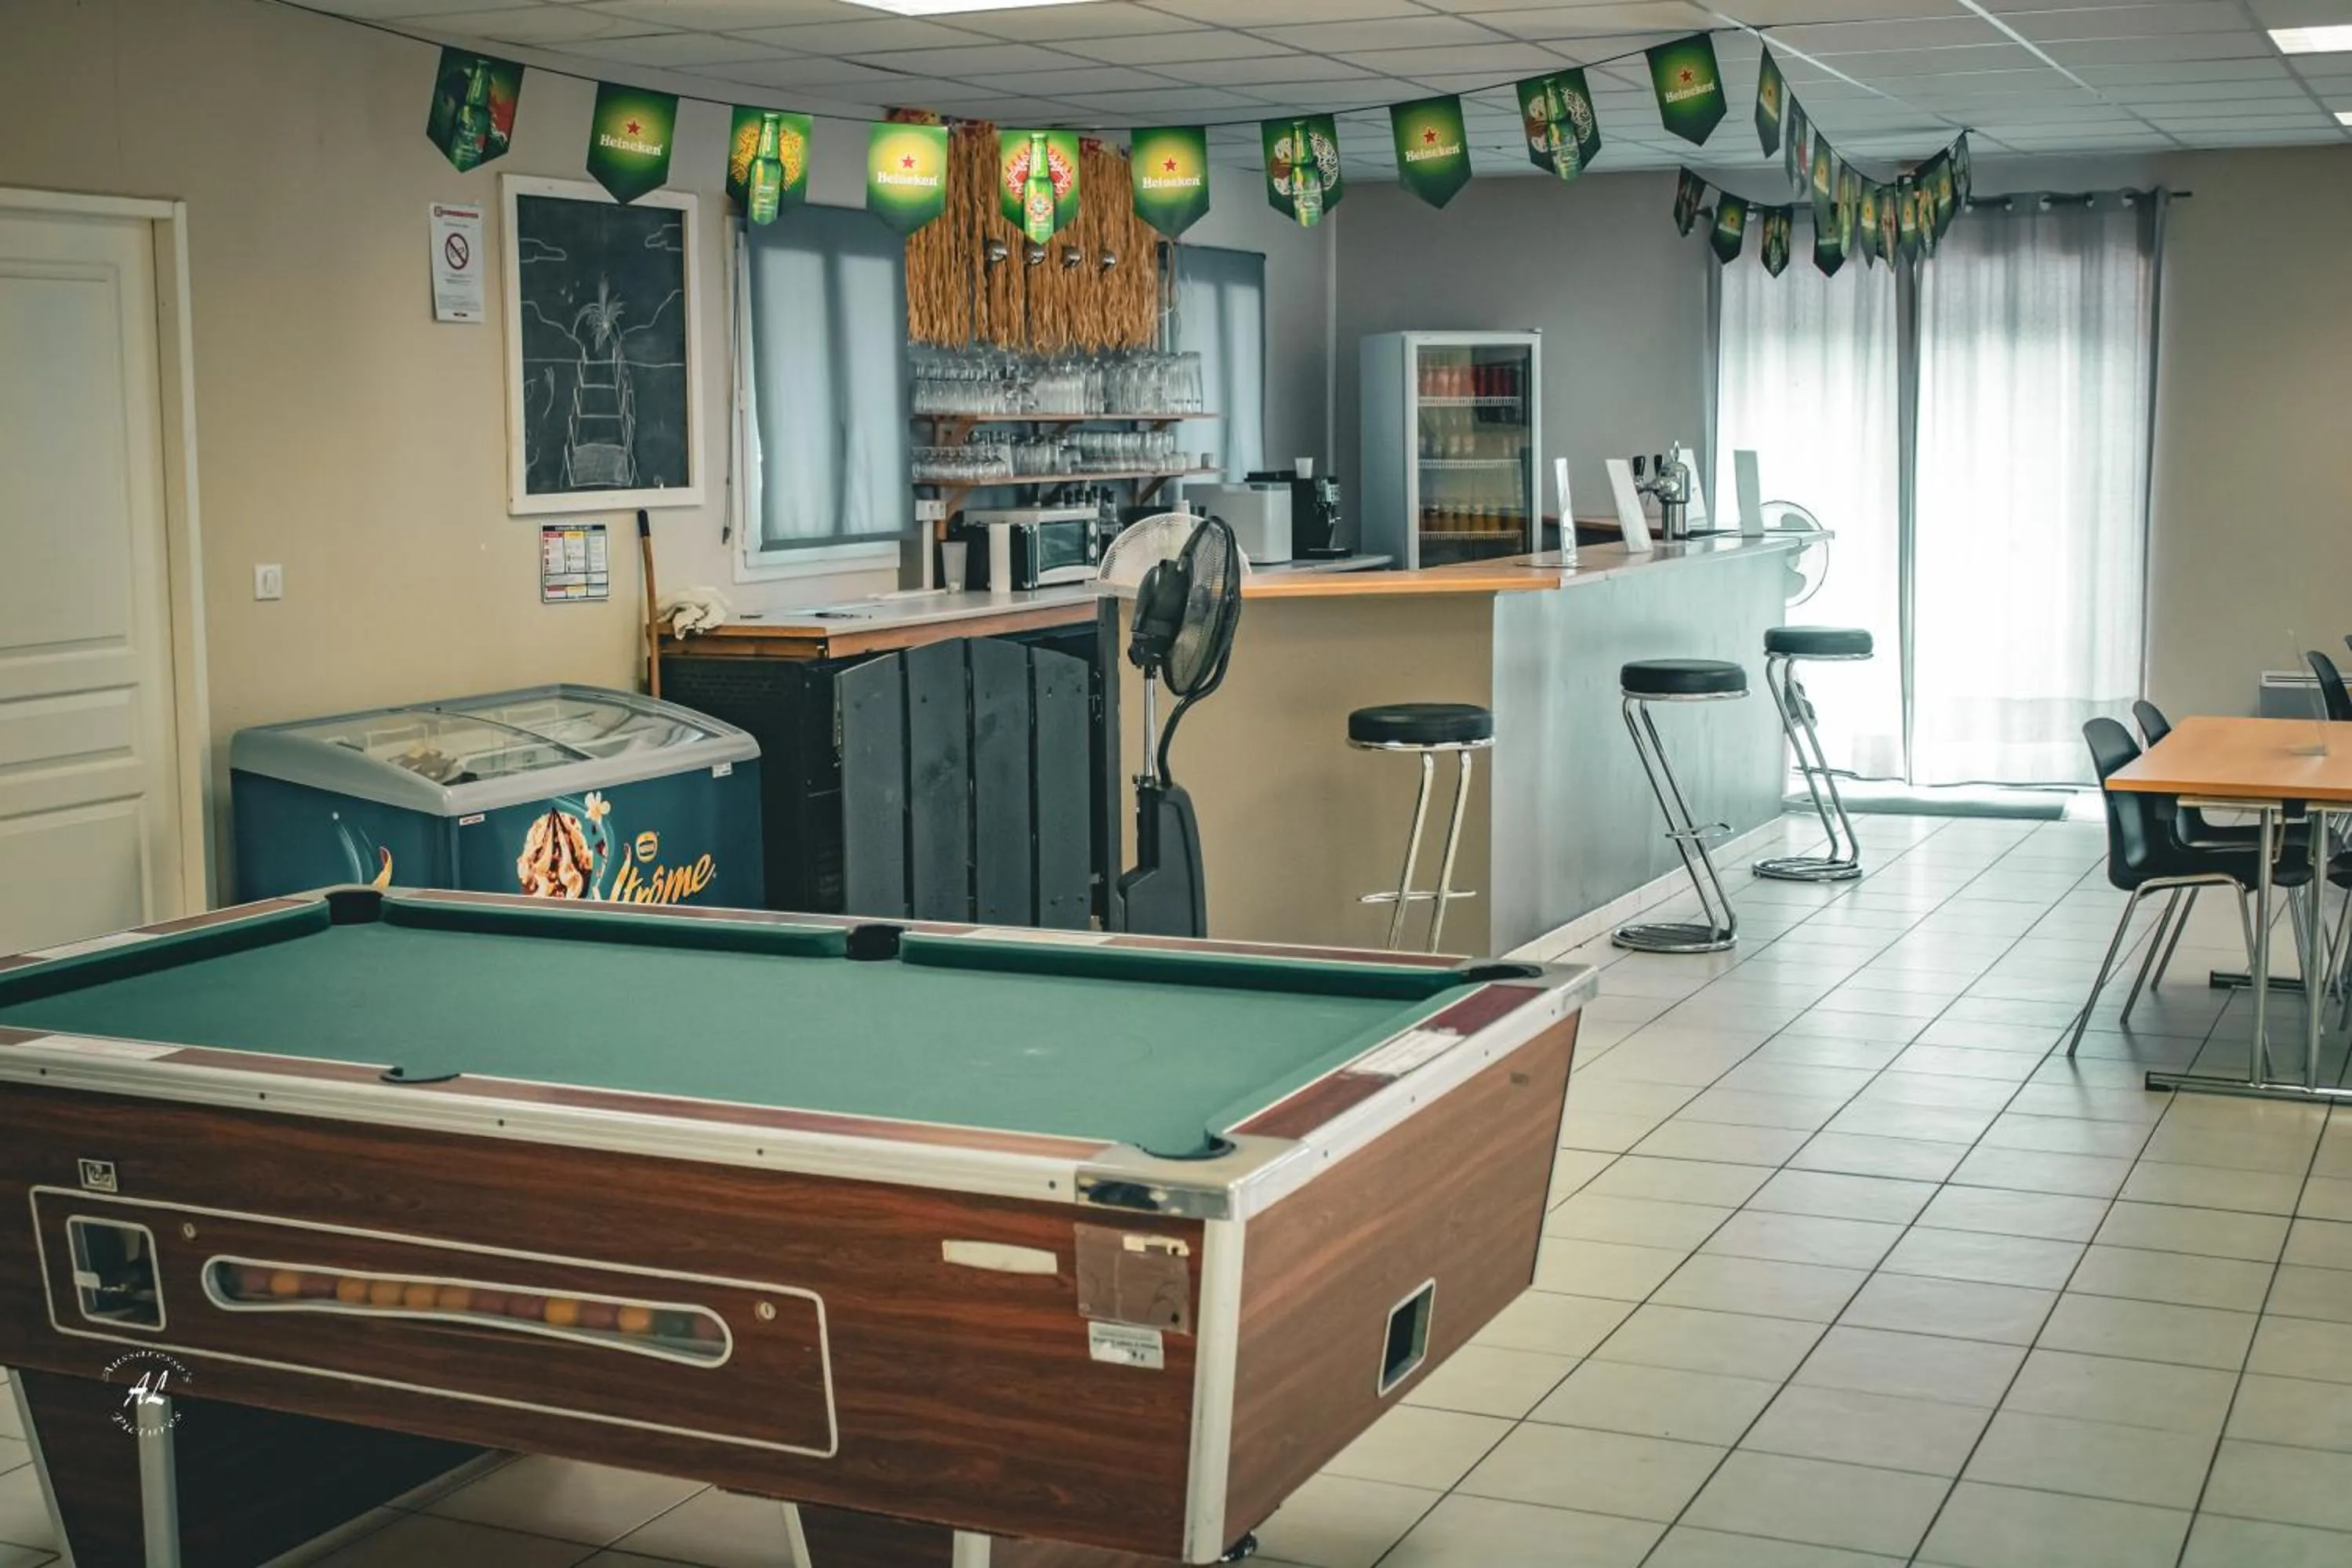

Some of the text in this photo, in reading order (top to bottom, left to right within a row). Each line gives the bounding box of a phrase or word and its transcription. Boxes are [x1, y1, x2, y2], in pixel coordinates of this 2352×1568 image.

[1665, 81, 1715, 103] Heineken
[600, 134, 660, 156] Heineken
[1405, 145, 1460, 162] Heineken
[877, 171, 938, 186] Heineken
[1142, 176, 1200, 188] Heineken
